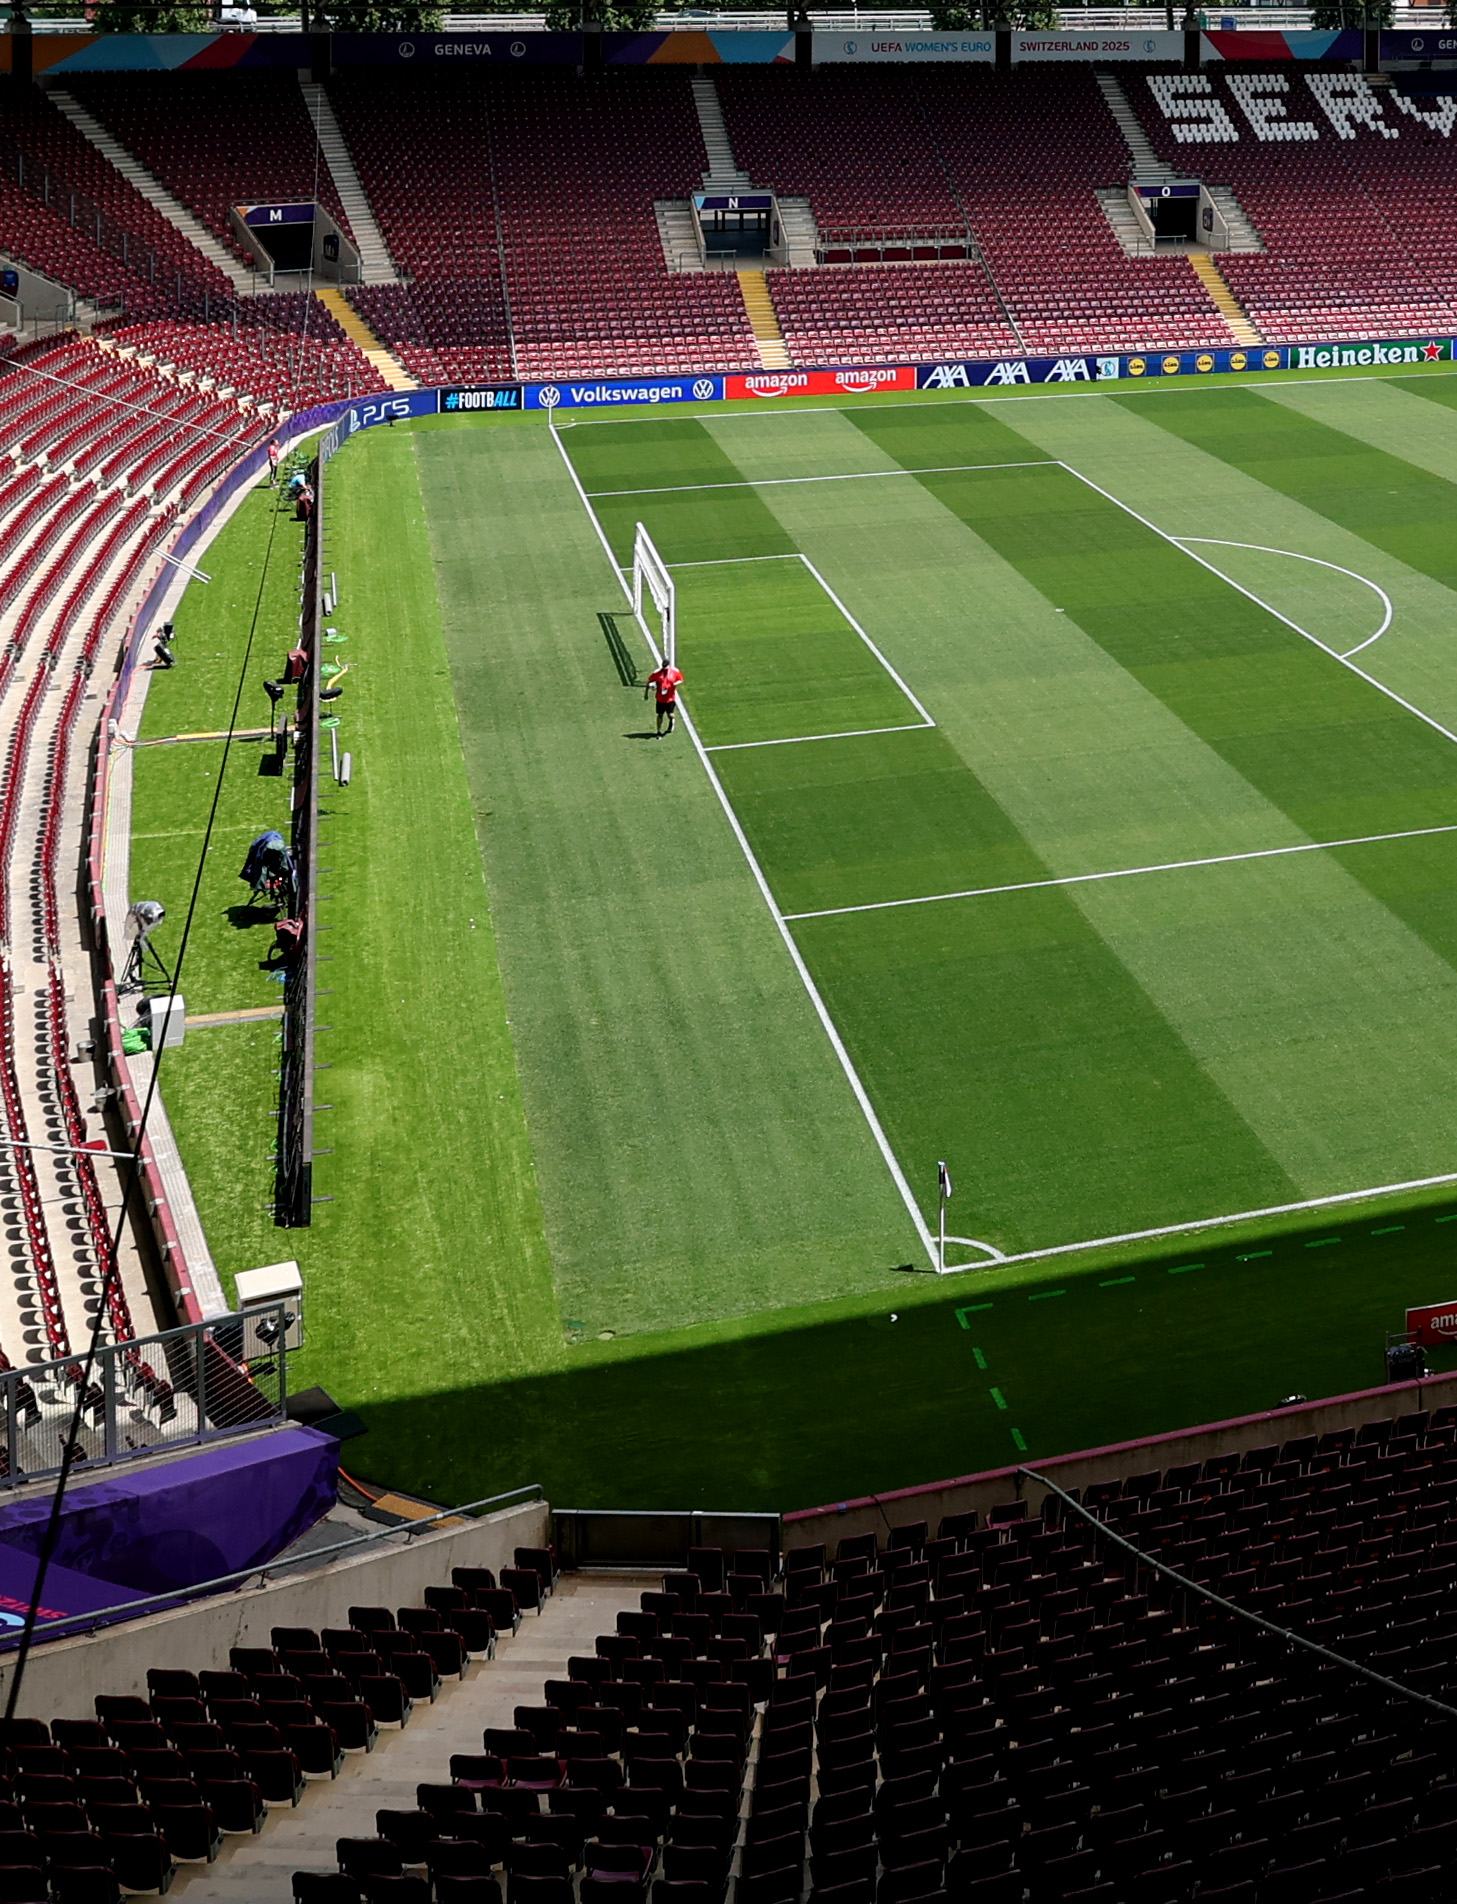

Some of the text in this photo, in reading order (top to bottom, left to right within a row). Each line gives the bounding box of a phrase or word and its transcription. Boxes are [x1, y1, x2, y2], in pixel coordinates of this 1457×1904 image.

[434, 44, 492, 56] GENEVA
[871, 42, 991, 53] UEFA WOMEN'S EURO
[1019, 42, 1130, 52] SWITZERLAND 2025
[728, 198, 739, 208] N
[270, 209, 282, 222] M
[1297, 345, 1419, 369] Heineken
[835, 368, 896, 386] amazon
[922, 365, 970, 389] AXA
[984, 362, 1032, 386] AXA
[1044, 358, 1091, 382] AXA
[744, 371, 808, 390] amazon
[445, 391, 518, 410] #FOOTBALL
[570, 383, 682, 403] Volkswagen
[362, 398, 410, 425] PS5
